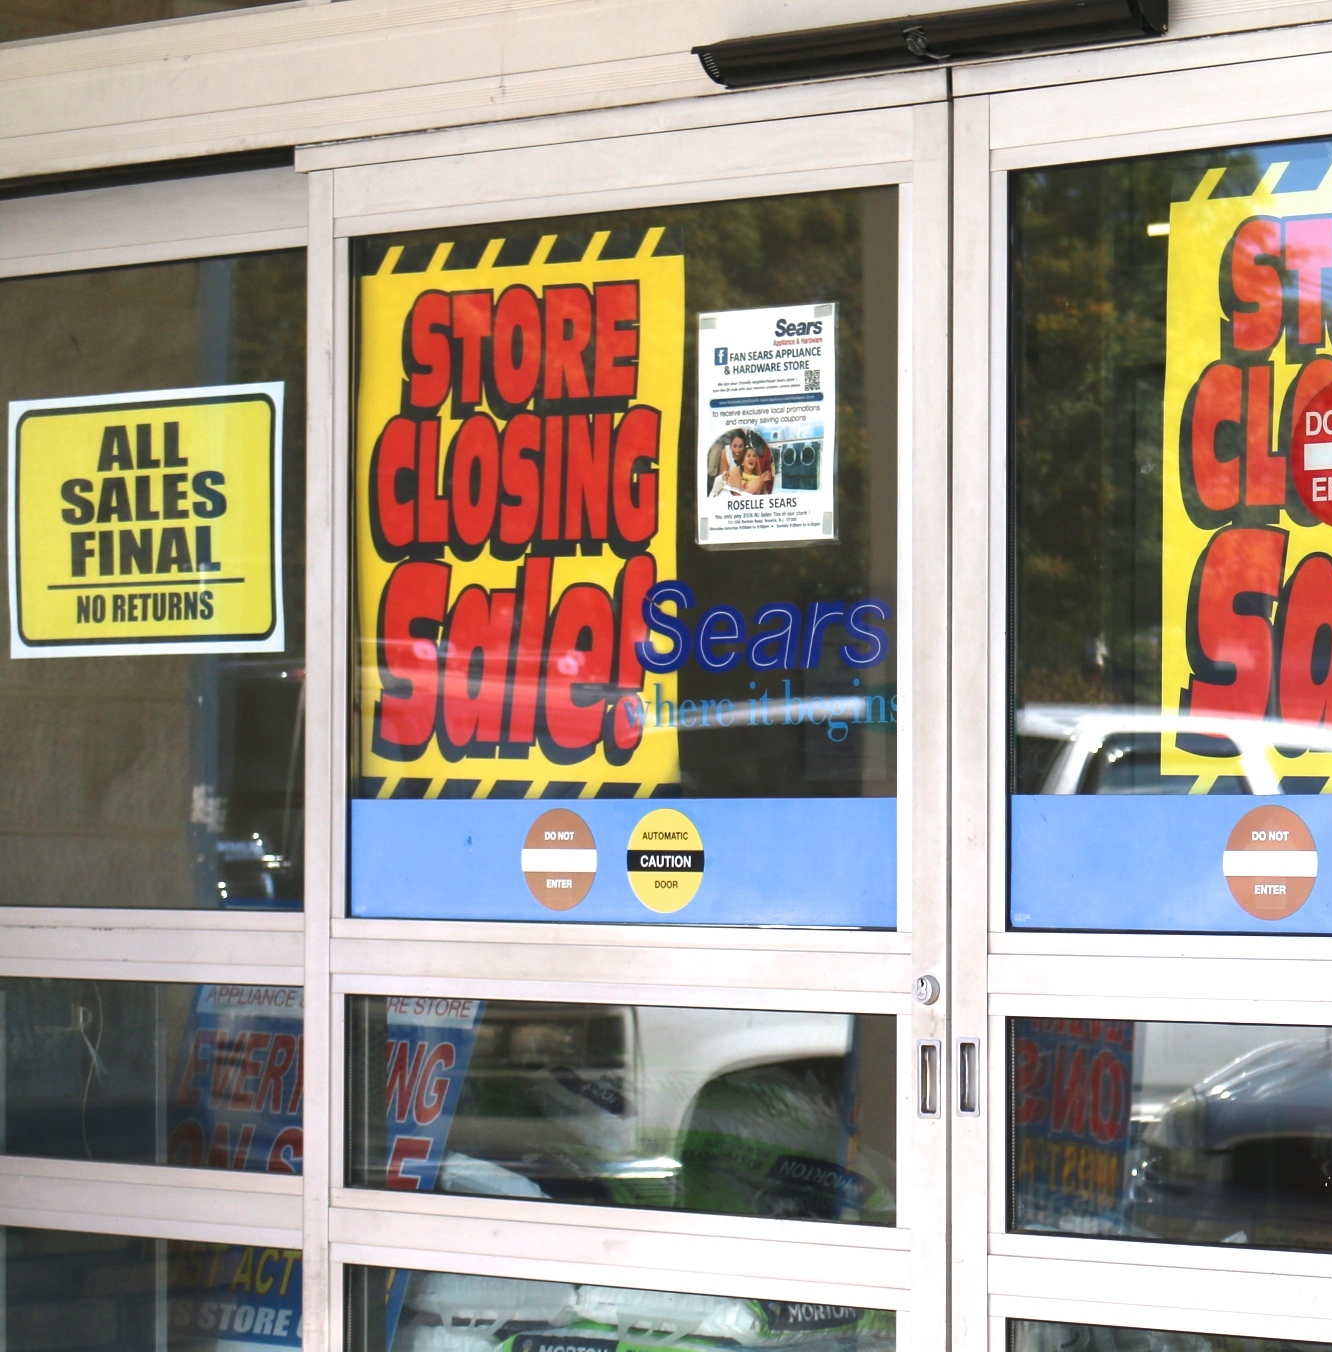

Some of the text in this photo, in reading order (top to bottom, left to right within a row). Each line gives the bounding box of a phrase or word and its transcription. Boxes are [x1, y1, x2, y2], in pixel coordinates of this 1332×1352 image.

[775, 319, 823, 337] Sears
[401, 279, 640, 416] STORE
[773, 339, 795, 347] Appliance
[730, 352, 746, 362] FAN
[747, 350, 773, 361] SEARS
[775, 346, 821, 359] APPLIANCE
[724, 360, 809, 375] & HARDWARE STORE
[720, 409, 740, 417] receive
[742, 407, 769, 416] exclusive
[770, 406, 785, 414] local
[786, 404, 820, 414] promotions
[725, 414, 806, 427] and money saving coupons
[97, 421, 188, 473] ALL
[369, 404, 661, 563] CLOSING
[60, 470, 228, 526] SALES
[727, 497, 797, 511] ROSELLE SEARS
[70, 525, 222, 577] FINAL
[76, 590, 214, 624] NO RETURNS
[635, 580, 892, 674] Sears
[372, 552, 657, 767] Sale!
[624, 682, 734, 728] where
[747, 681, 774, 726] it
[544, 831, 574, 841] DO NOT
[642, 831, 689, 841] AUTOMATIC
[1251, 830, 1289, 841] DO NOT
[640, 855, 692, 868] CAUTION
[546, 879, 572, 889] ENTER
[654, 880, 678, 889] DOOR
[1254, 884, 1286, 895] ENTER
[206, 986, 297, 1007] APPLIANCE
[413, 998, 473, 1018] STORE
[200, 1304, 292, 1337] STORE
